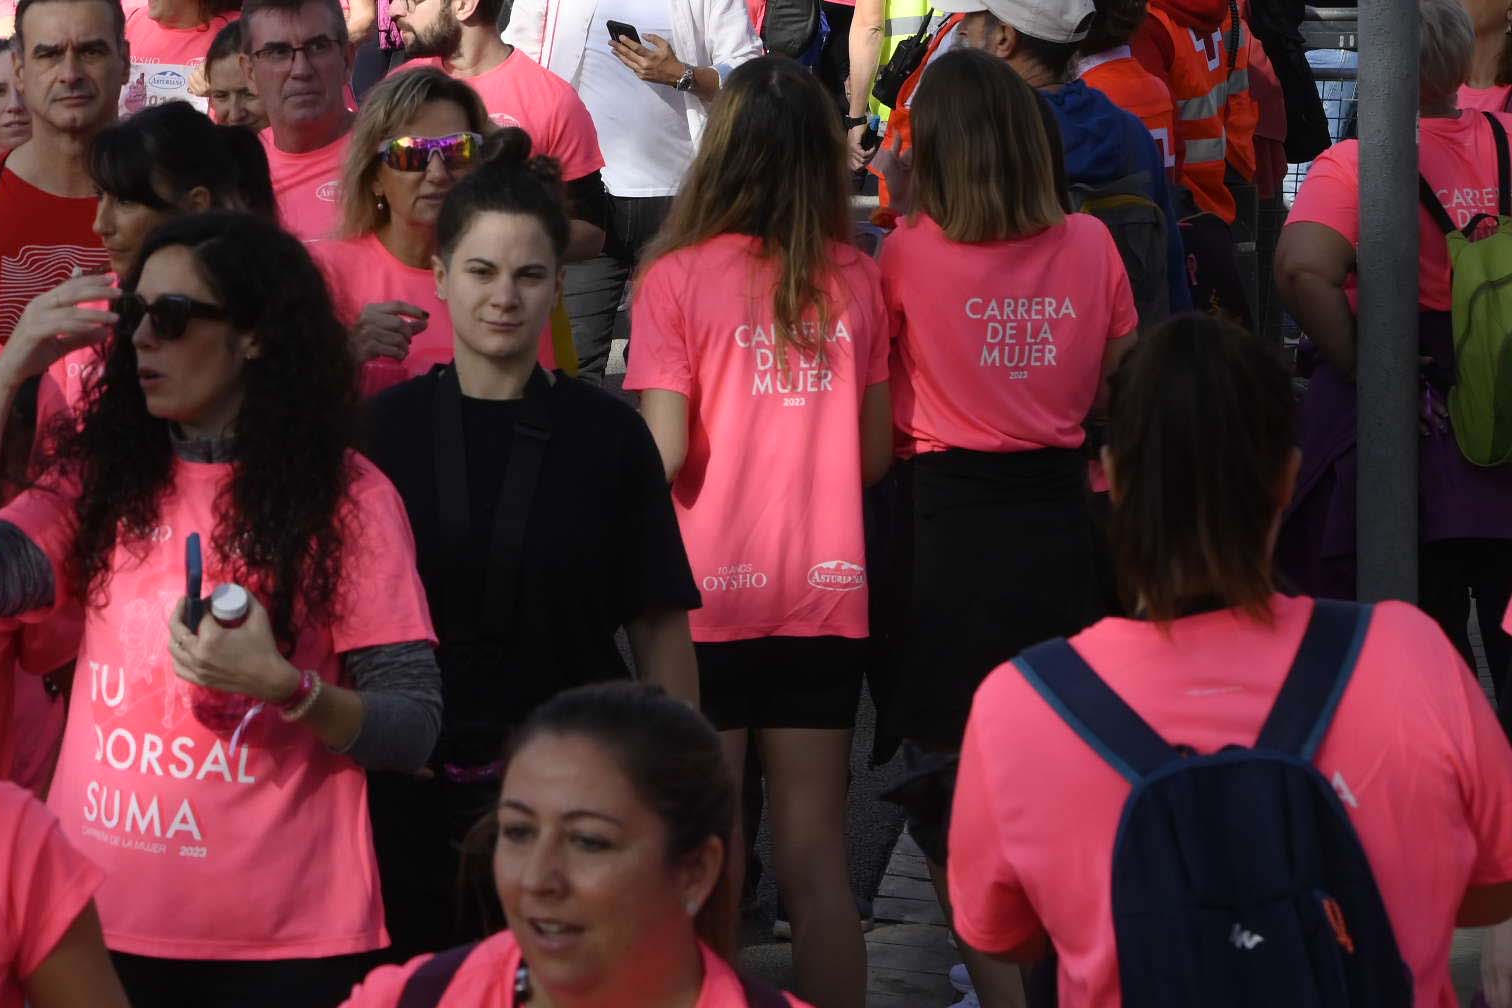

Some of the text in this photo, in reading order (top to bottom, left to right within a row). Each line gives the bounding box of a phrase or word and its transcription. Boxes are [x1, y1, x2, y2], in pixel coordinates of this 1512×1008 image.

[965, 296, 1077, 320] CARRERA
[986, 321, 1054, 344] DE LA
[979, 344, 1057, 368] MUJER
[751, 369, 833, 396] MUJER
[783, 397, 806, 407] 2023
[703, 572, 767, 592] OYSHO
[83, 780, 202, 841] SUMA
[179, 845, 207, 858] 2023
